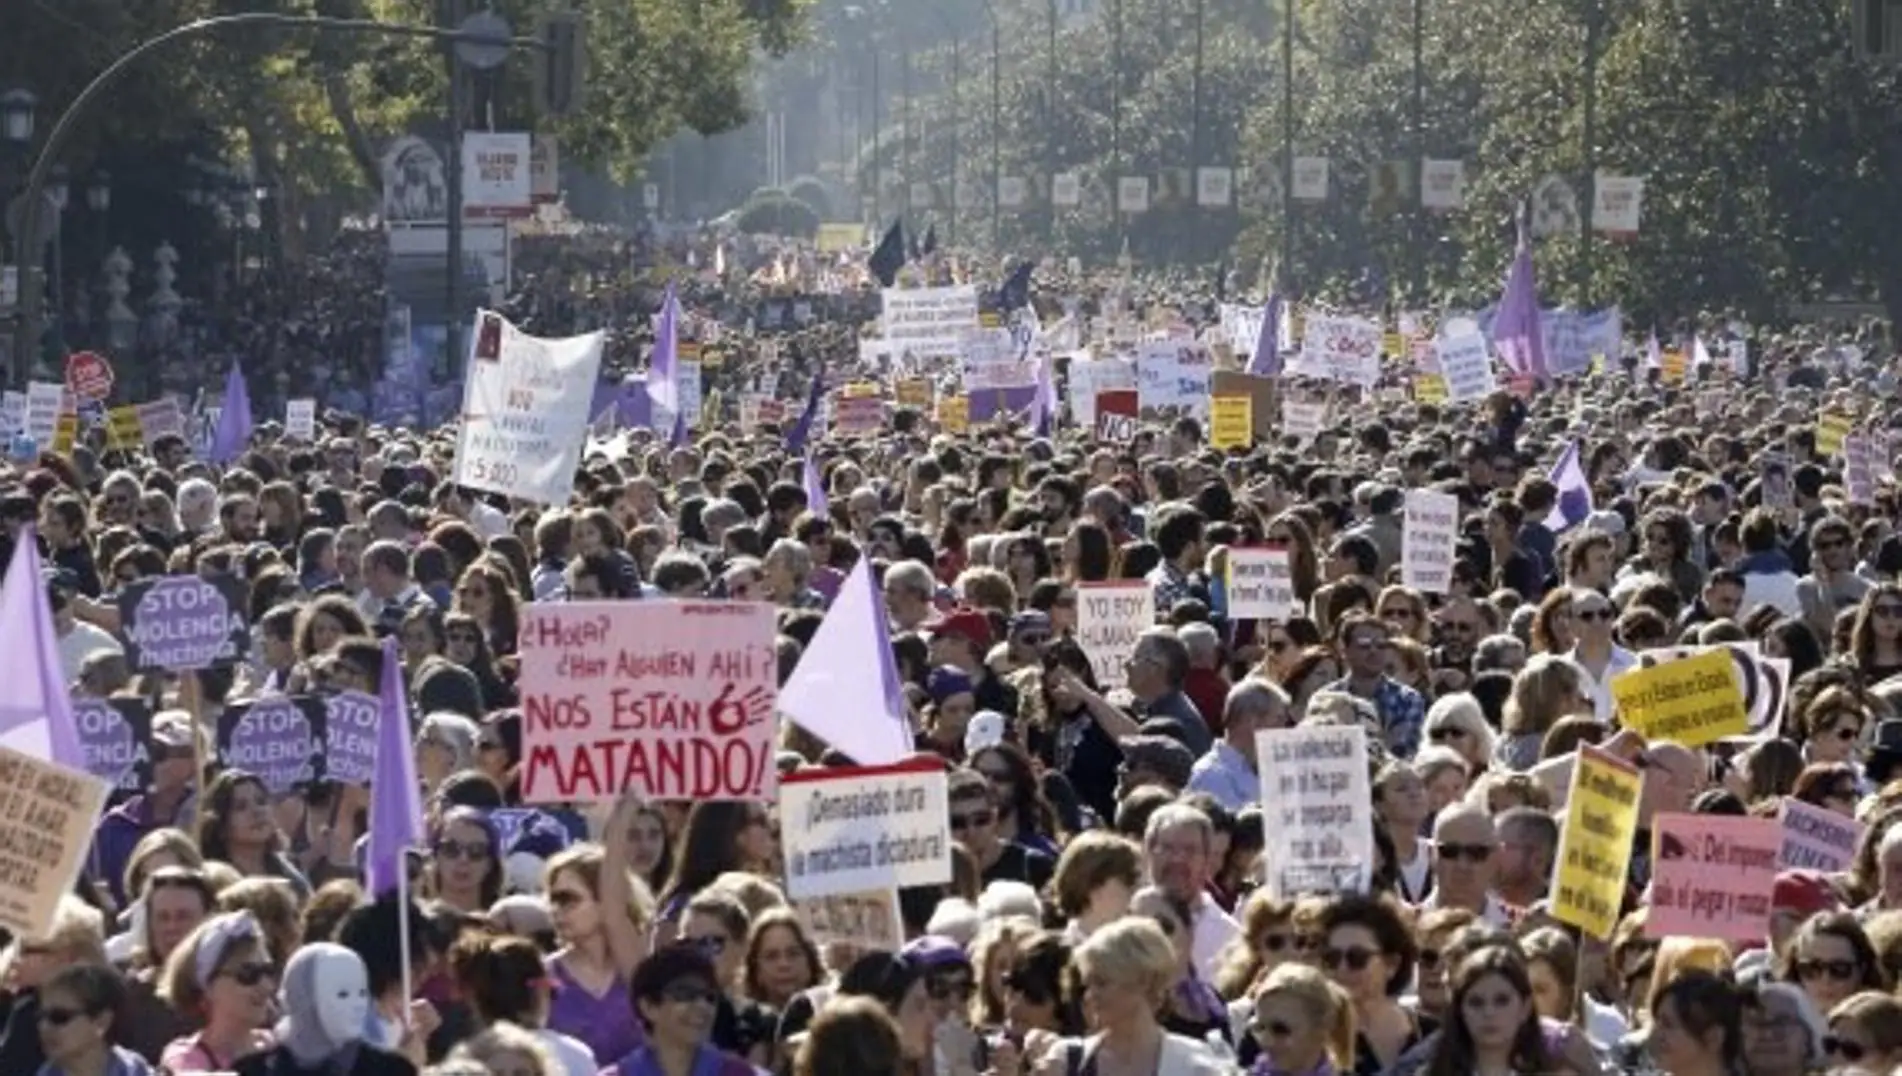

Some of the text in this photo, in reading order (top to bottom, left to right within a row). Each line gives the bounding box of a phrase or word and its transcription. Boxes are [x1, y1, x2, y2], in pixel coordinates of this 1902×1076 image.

[142, 585, 219, 613] STOP
[122, 611, 245, 643] VIOLENCIA
[240, 706, 303, 737] STOP
[327, 701, 381, 733] STO
[526, 689, 700, 734] NOS ESTÁN
[220, 736, 323, 764] VIOLENCIA
[1295, 734, 1352, 760] violencia
[523, 738, 769, 797] MATANDO!
[1312, 769, 1350, 798] hogar
[806, 780, 926, 831] ¡Demasiado dura
[807, 840, 872, 874] machista
[876, 826, 946, 866] dictadura!
